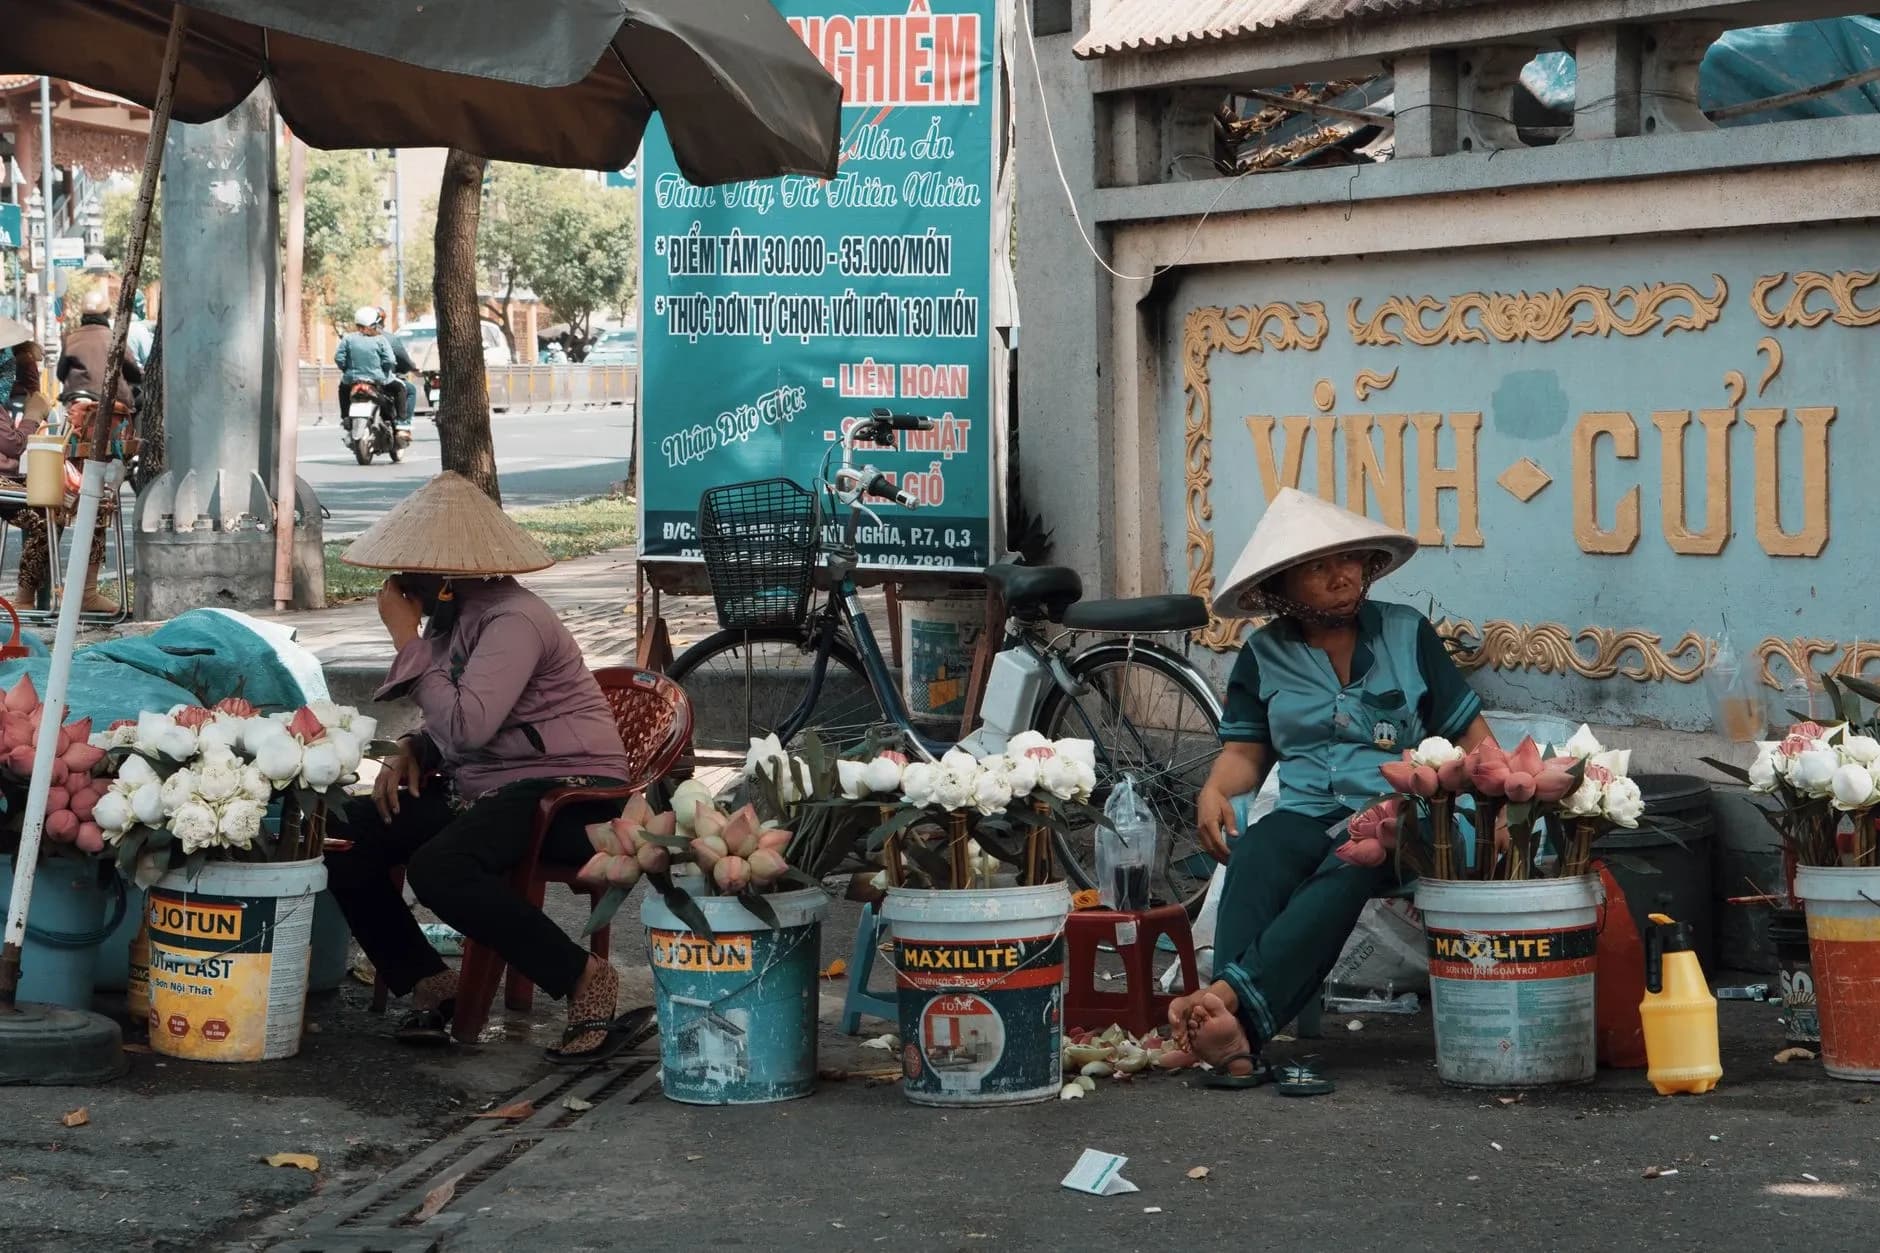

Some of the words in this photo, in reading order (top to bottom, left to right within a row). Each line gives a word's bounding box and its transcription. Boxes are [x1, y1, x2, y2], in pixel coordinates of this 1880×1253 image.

[787, 0, 980, 106] GHIÊM
[849, 124, 906, 160] Món
[910, 116, 954, 159] Ăn
[826, 171, 898, 208] Thiên
[903, 171, 981, 208] Nhiên
[668, 221, 716, 276] ĐIỂM
[719, 228, 760, 276] TÂM
[763, 236, 825, 276] 30.000
[840, 227, 951, 276] 35.000/MÓN
[667, 292, 711, 344] THỰC
[713, 292, 750, 336] ĐƠN
[752, 292, 777, 344] TỰ
[777, 295, 829, 344] CHỌN:
[830, 288, 860, 337] VỚI
[862, 292, 899, 337] HƠN
[901, 297, 934, 337] 130
[936, 288, 978, 337] MÓN
[840, 357, 895, 398] LIÊN
[901, 364, 969, 399] HOAN
[661, 424, 717, 468] Nhận
[716, 404, 759, 446] Đặc
[906, 412, 971, 460] NHẬT
[1572, 336, 1837, 557] CỬU
[663, 522, 696, 540] Đ/C:
[911, 528, 939, 548] P.7,
[944, 529, 971, 547] Q.3
[160, 907, 235, 935] JOTUN
[667, 943, 745, 966] JOTUN
[904, 947, 1018, 969] MAXILITE
[1436, 938, 1551, 958] MAXLITE
[170, 982, 186, 993] Nội
